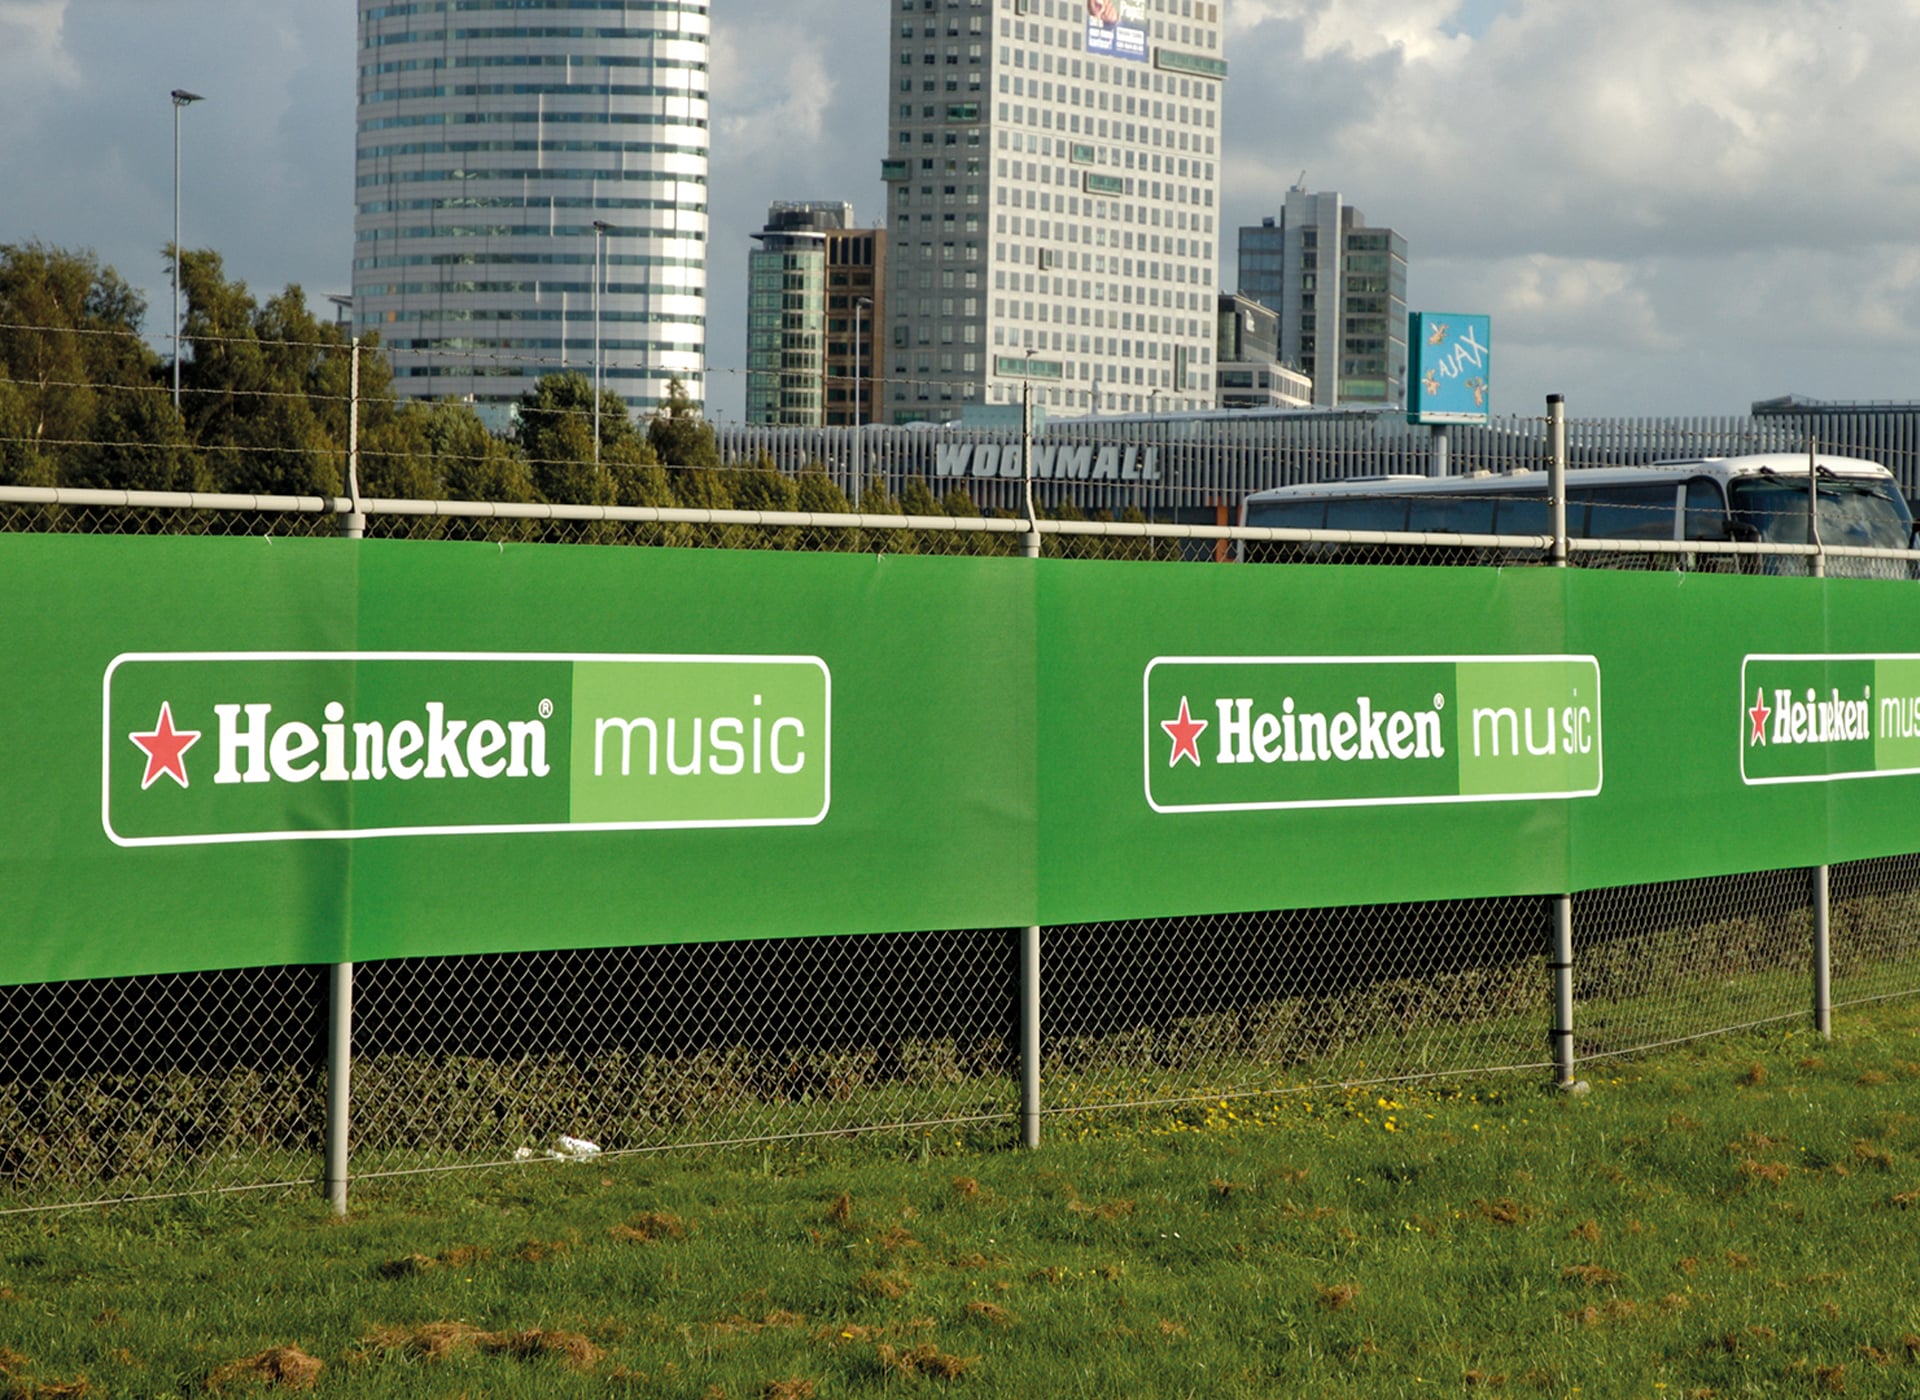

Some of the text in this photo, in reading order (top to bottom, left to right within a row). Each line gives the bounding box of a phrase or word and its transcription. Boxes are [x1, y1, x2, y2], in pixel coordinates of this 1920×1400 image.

[1438, 324, 1489, 379] AJAX
[214, 694, 806, 785] Heineken music
[1215, 688, 1593, 764] Heineken music
